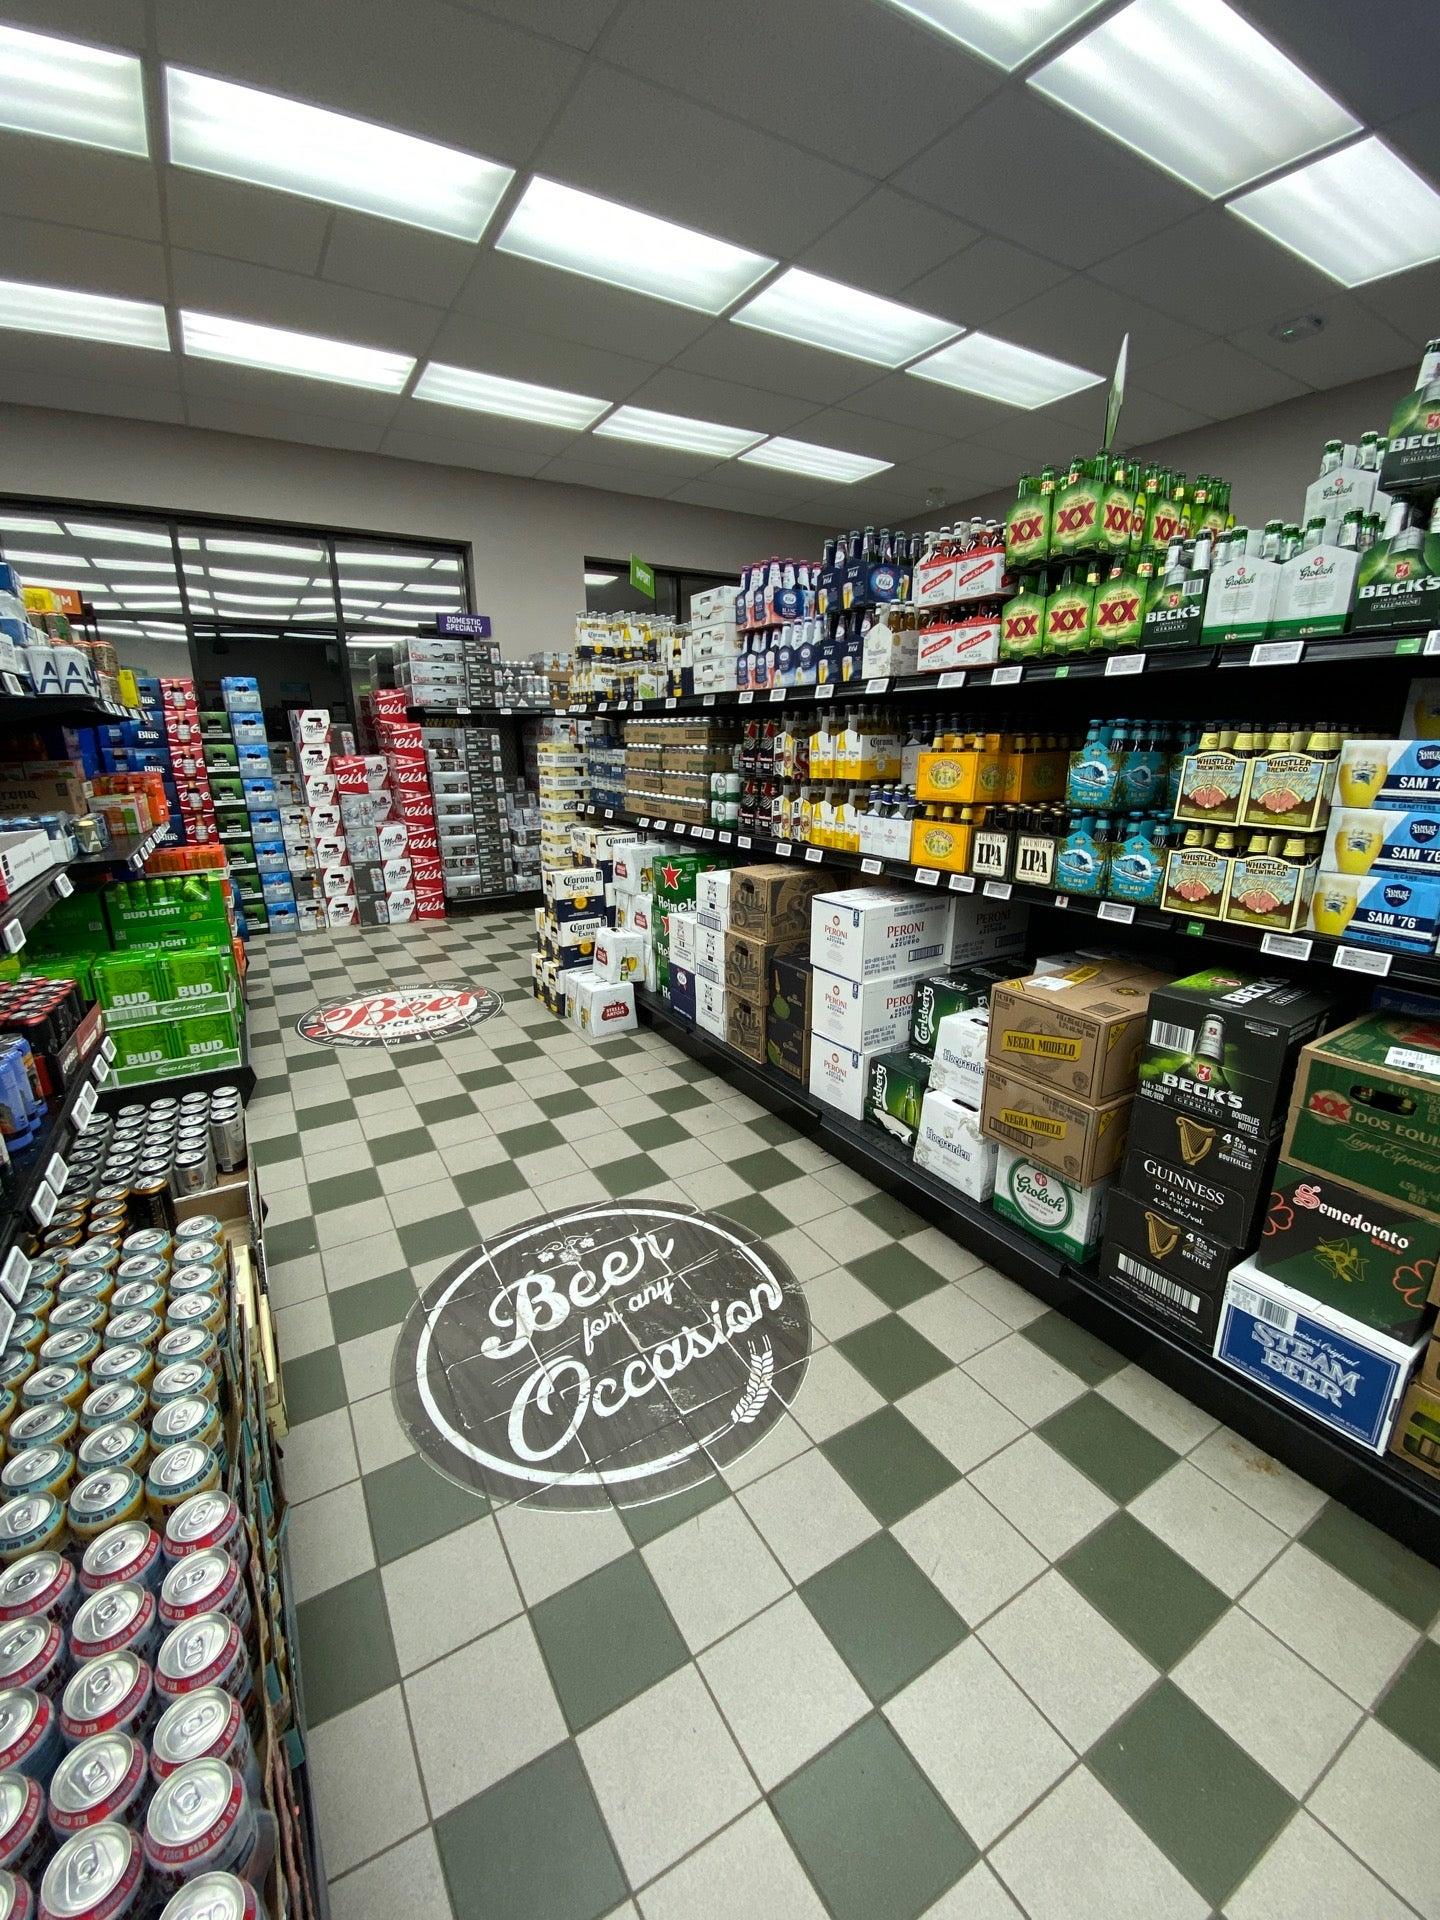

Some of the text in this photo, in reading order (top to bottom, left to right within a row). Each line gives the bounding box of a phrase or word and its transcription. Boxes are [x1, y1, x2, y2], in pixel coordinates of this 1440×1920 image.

[1389, 432, 1440, 453] BEC
[1323, 481, 1354, 499] Grolsch
[1056, 502, 1096, 534] XX
[1104, 504, 1132, 533] XX
[1010, 515, 1043, 545] XX
[1224, 572, 1256, 589] Grolsch
[1299, 562, 1336, 581] Grolsch
[1359, 574, 1440, 600] BECK'S
[446, 616, 481, 626] DOMESTIC
[1048, 607, 1087, 634] XX
[1097, 598, 1140, 626] XX
[1145, 604, 1201, 624] BECK'S
[445, 623, 483, 633] SPECIALTY
[1005, 615, 1038, 639] XX
[138, 730, 159, 739] Blue
[869, 738, 894, 748] Corona
[1196, 757, 1236, 766] WHISTLER
[1266, 758, 1312, 767] WHISTLER
[1266, 765, 1298, 773] BREWING
[1399, 777, 1429, 789] SAM
[606, 833, 636, 847] Corona
[976, 832, 1005, 844] LAGUNITAS
[1020, 838, 1051, 849] LAGUNITAS
[976, 843, 1002, 867] IPA
[1020, 848, 1048, 874] IPA
[1181, 853, 1219, 863] WHISTLER
[1391, 847, 1421, 860] SAM
[1181, 859, 1208, 868] BREWING
[1245, 860, 1289, 872] WHISTLER
[1245, 868, 1277, 876] BREWING
[563, 875, 597, 887] Corona
[572, 883, 589, 891] Extra
[1385, 887, 1409, 895] SAMUEL
[122, 903, 209, 920] BUD LIGHT LIME
[1367, 911, 1417, 929] SAM '76
[570, 922, 600, 933] Corona
[824, 924, 848, 940] PERONI
[887, 921, 925, 939] PERONI
[190, 934, 216, 944] LIME
[890, 938, 920, 949] AZZURRO
[177, 982, 213, 998] BUD
[112, 991, 150, 1008] BUD
[825, 993, 848, 1010] PERONI
[304, 984, 488, 1037] Beer
[606, 1005, 625, 1014] STELLA
[914, 985, 935, 1045] Carlsberg
[374, 1013, 447, 1031] O'CLOCK
[189, 1039, 224, 1054] BUD
[1006, 1035, 1076, 1057] NEGRA MODELO
[126, 1049, 163, 1066] BUD
[823, 1060, 848, 1078] PERONI
[1161, 1071, 1243, 1110] BECK'S
[1176, 1095, 1221, 1116] GERMANY
[1182, 1093, 1216, 1107] IMPORTED
[1311, 1093, 1351, 1124] XX
[1004, 1112, 1062, 1136] NEGRA MODELO
[1231, 1110, 1260, 1127] BOUTEILLES
[1354, 1111, 1391, 1132] DOS
[1237, 1121, 1259, 1135] BOTTLES
[926, 1126, 971, 1162] Hoegaarden
[1222, 1133, 1232, 1145] 4
[1338, 1131, 1385, 1154] Lager
[1247, 1147, 1258, 1156] mL
[1218, 1152, 1252, 1170] BOUTEILLES
[1143, 1159, 1225, 1206] GUINNESS
[1016, 1173, 1066, 1212] Grolsch
[1154, 1183, 1206, 1212] DRAUGHT
[1152, 1197, 1205, 1226] 4.2% alc./vol.
[1168, 1196, 1190, 1209] STOUT
[1292, 1182, 1409, 1250] Semedorato
[1185, 1232, 1195, 1243] 4
[1181, 1249, 1211, 1269] BOTTLES
[480, 1230, 675, 1360] Beer
[583, 1277, 674, 1356] for any
[1251, 1320, 1361, 1397] STEAM
[1321, 1342, 1361, 1368] Original
[507, 1281, 783, 1462] Occasion
[1261, 1347, 1343, 1409] BEER
[121, 1564, 138, 1580] HARD
[111, 1632, 129, 1651] PEACH
[69, 1691, 142, 1734] ICED TEA GEORGIA
[15, 1720, 43, 1756] ICED TEA
[75, 1815, 88, 1827] TEA
[188, 1800, 238, 1856] HARD ICED TEA
